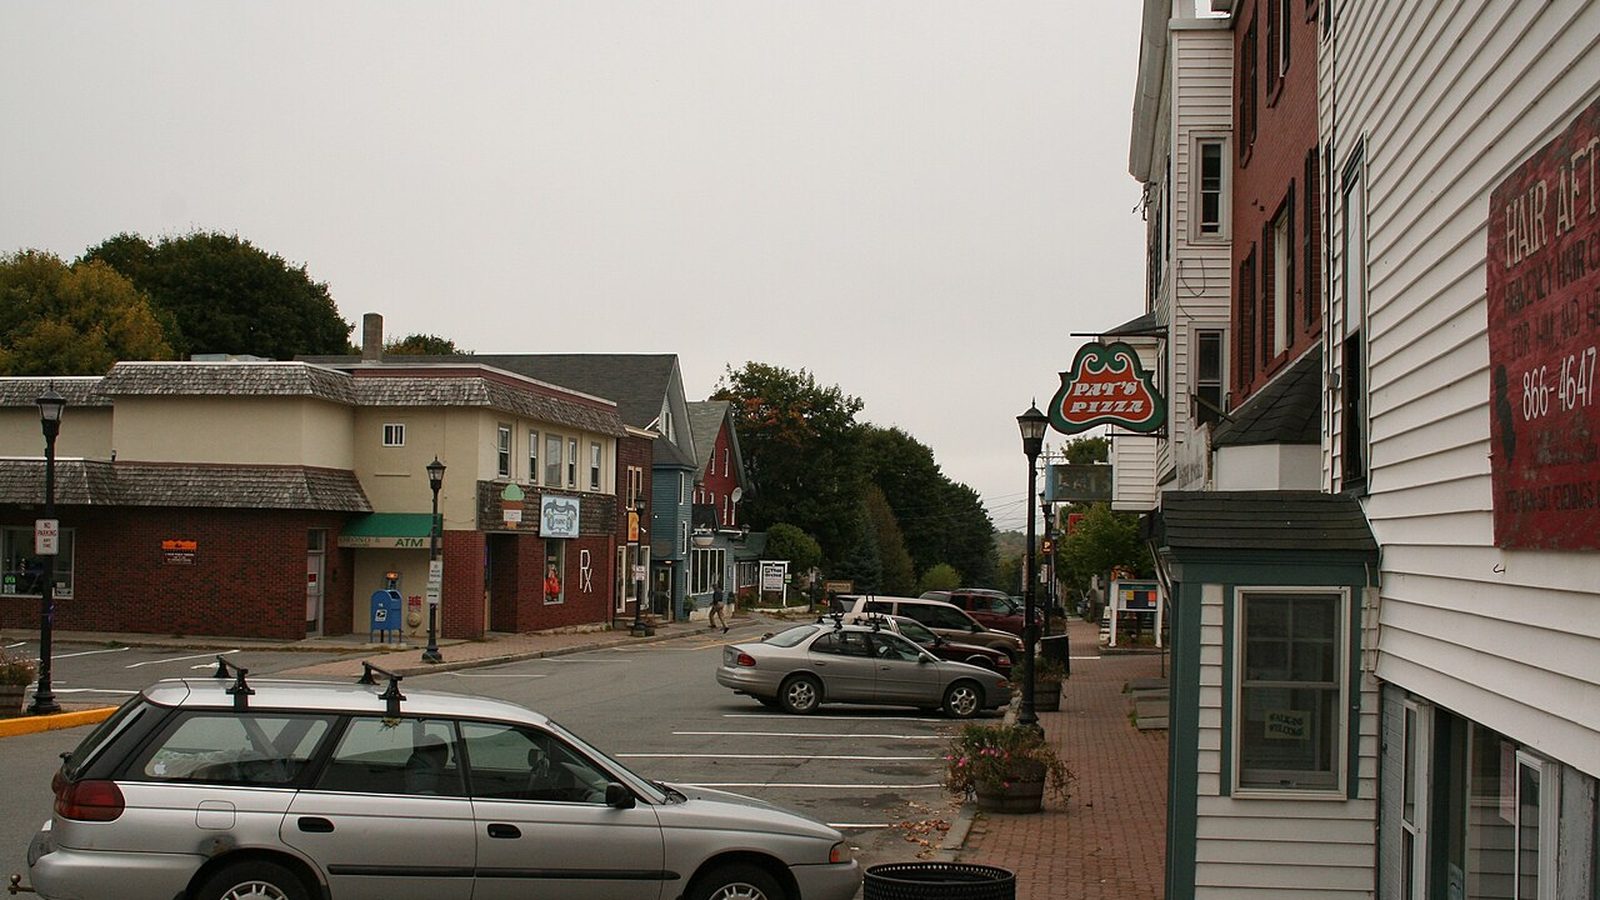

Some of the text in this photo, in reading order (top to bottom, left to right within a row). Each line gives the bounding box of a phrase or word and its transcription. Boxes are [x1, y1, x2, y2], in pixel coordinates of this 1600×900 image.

[1505, 180, 1548, 270] HAIR
[1556, 239, 1585, 290] HAIR
[1072, 381, 1137, 397] PAT'S
[1523, 346, 1596, 421] 866-4647
[1070, 400, 1144, 413] PIZZA
[38, 529, 57, 537] PARKING
[395, 538, 424, 547] ATM
[1269, 723, 1305, 737] WELCOME
